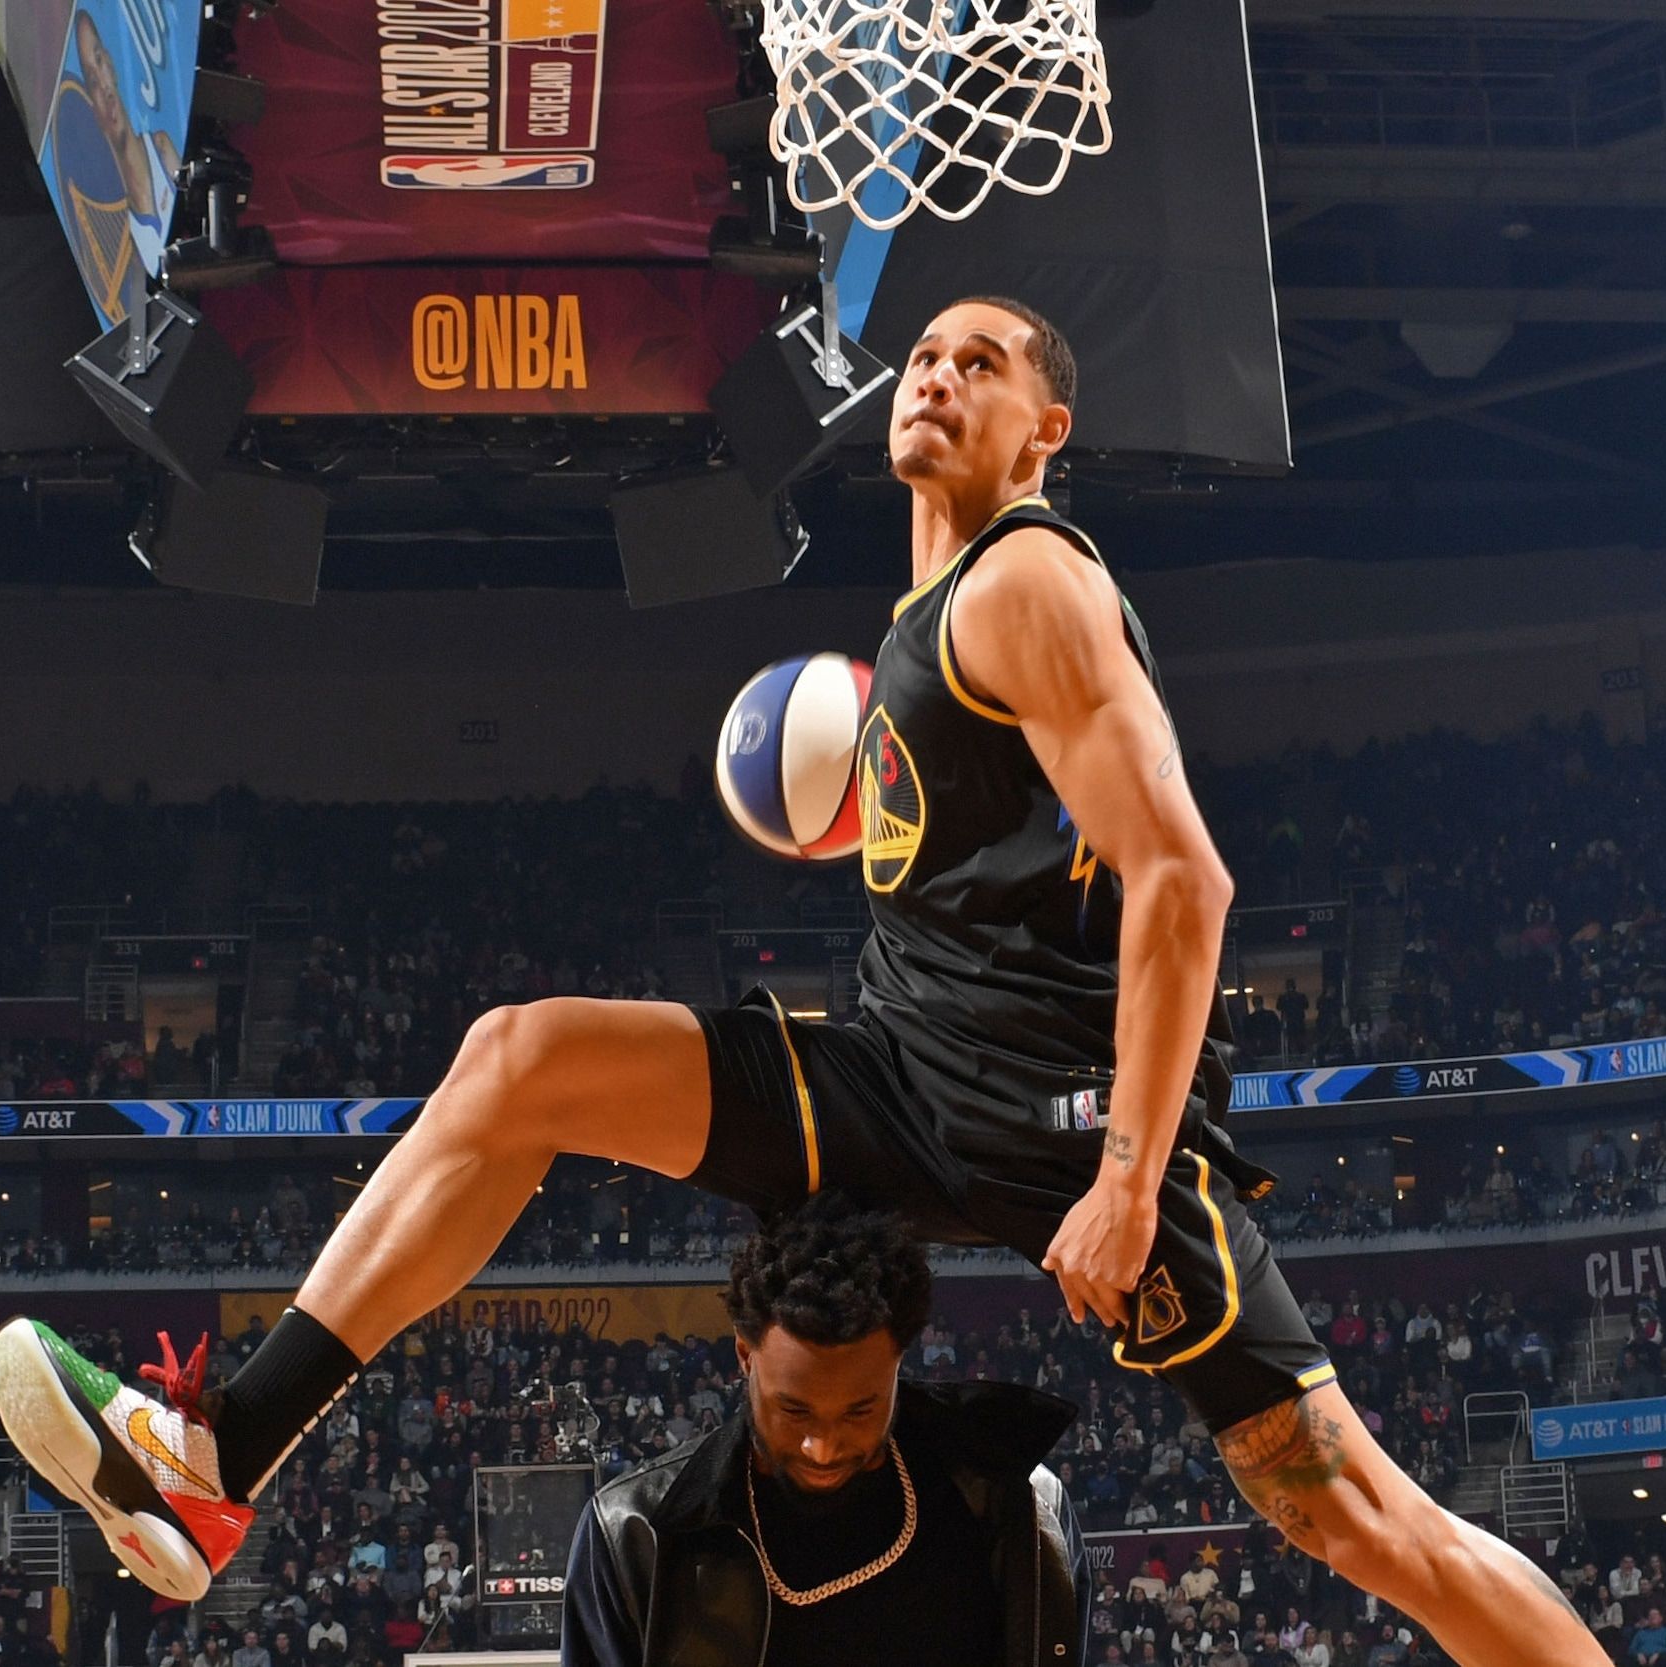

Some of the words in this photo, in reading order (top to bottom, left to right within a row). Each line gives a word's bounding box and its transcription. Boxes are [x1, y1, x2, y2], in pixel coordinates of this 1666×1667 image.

[380, 43, 490, 108] STAR
[528, 62, 573, 136] CLEVELAND
[384, 112, 488, 150] ALL
[413, 295, 588, 390] @NBA
[1234, 1077, 1270, 1107] UNK
[1426, 1067, 1478, 1089] AT&T
[23, 1111, 75, 1129] AT&T
[225, 1104, 270, 1132] SLAM
[276, 1103, 322, 1131] DUNK
[1569, 1420, 1617, 1440] AT&T
[1633, 1414, 1661, 1435] SLAM
